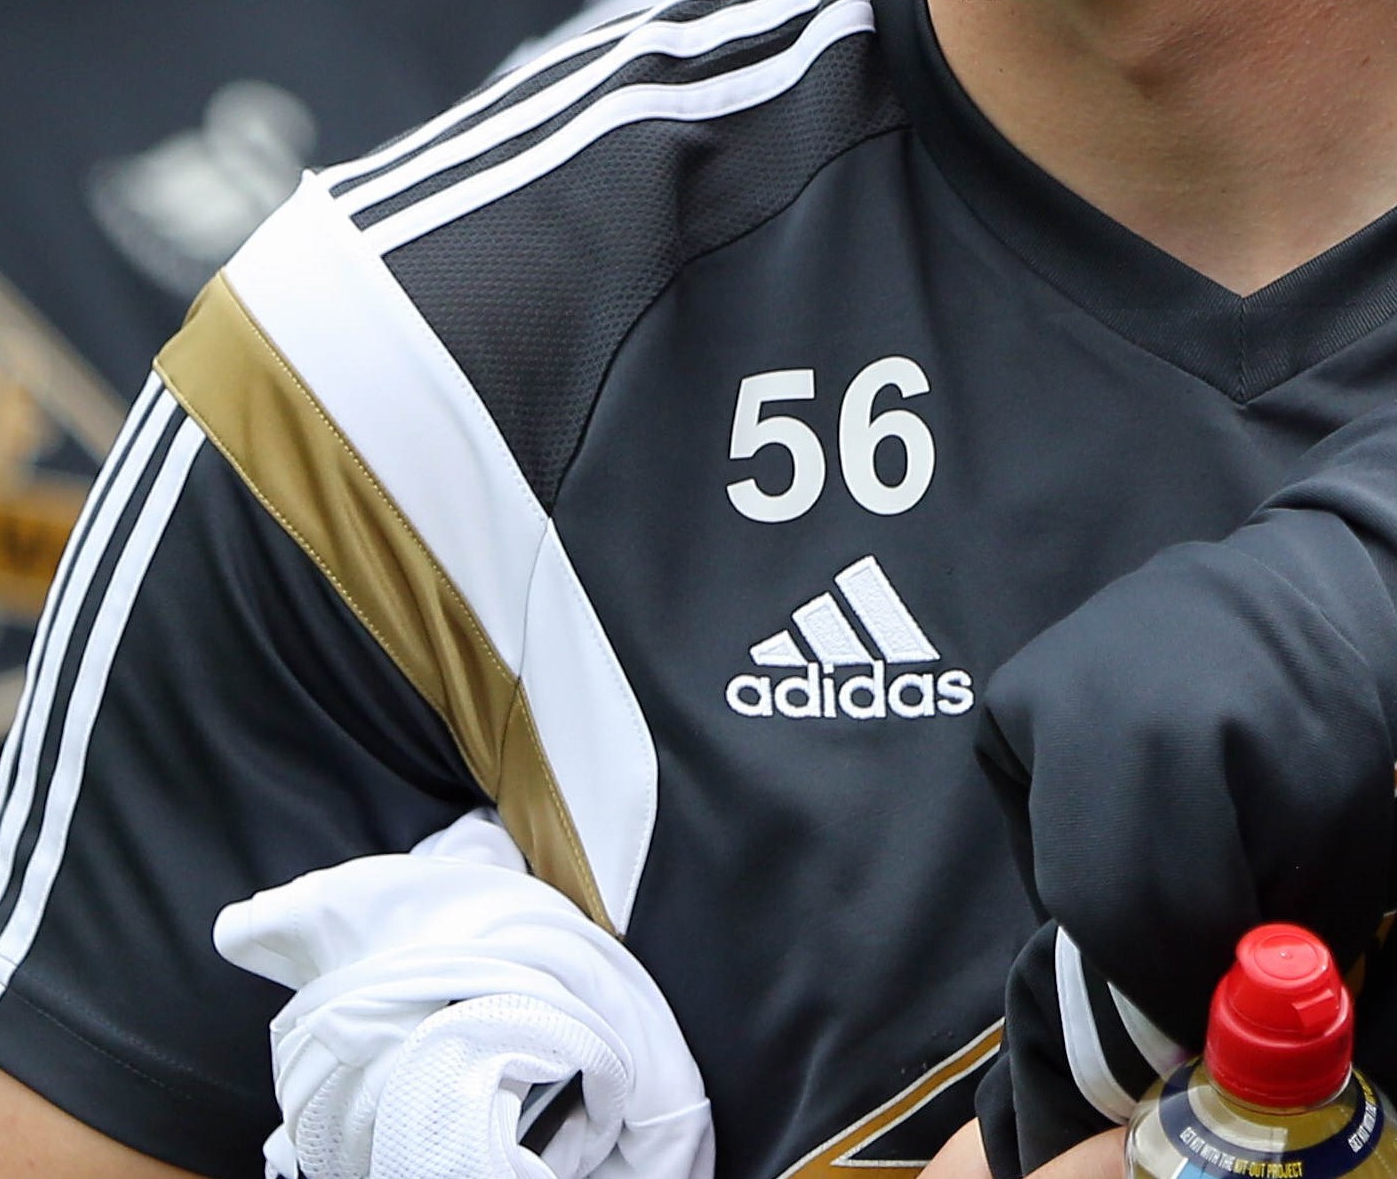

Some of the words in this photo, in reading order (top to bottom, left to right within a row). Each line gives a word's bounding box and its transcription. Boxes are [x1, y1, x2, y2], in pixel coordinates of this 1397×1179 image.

[725, 355, 936, 523] 56
[724, 659, 975, 720] adidas
[1266, 1161, 1302, 1179] PROJECT
